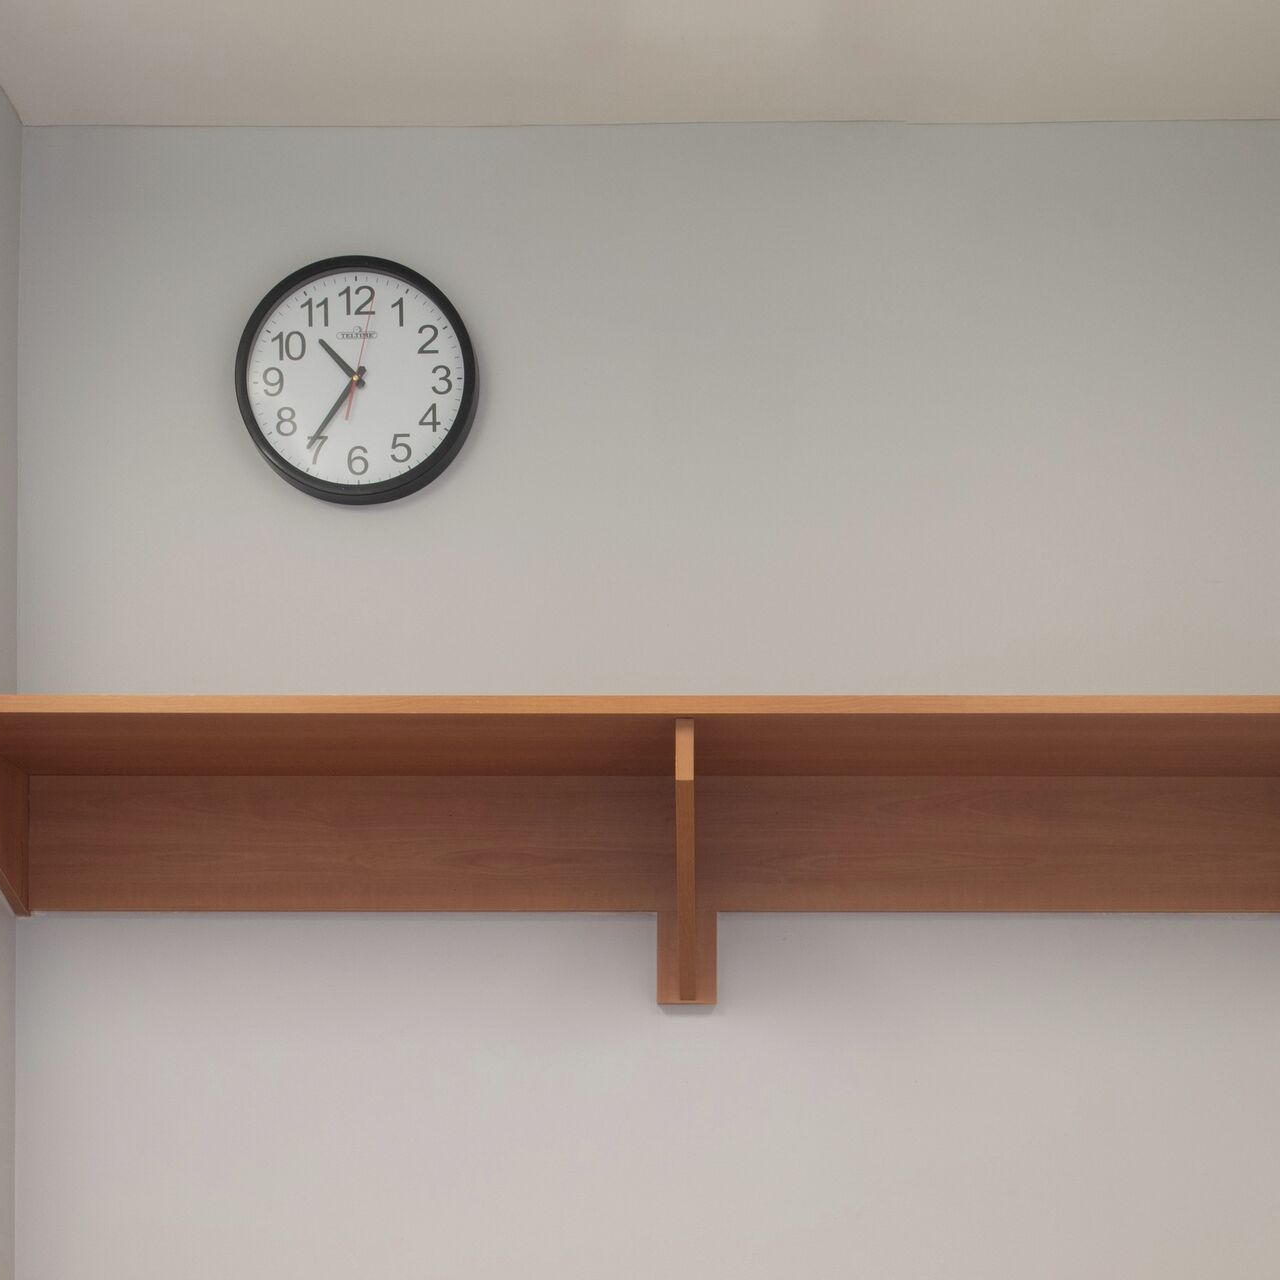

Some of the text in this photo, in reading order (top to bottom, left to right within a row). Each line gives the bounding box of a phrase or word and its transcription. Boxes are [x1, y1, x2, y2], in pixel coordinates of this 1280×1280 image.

[300, 297, 329, 327] 11
[338, 285, 376, 316] 12
[391, 297, 404, 327] 1
[270, 331, 306, 361] 10
[417, 324, 439, 354] 2
[262, 367, 284, 397] 9
[431, 365, 452, 395] 3
[275, 406, 298, 436] 8
[418, 403, 441, 433] 4
[307, 435, 329, 465] 7
[347, 446, 369, 476] 6
[390, 433, 412, 463] 5
